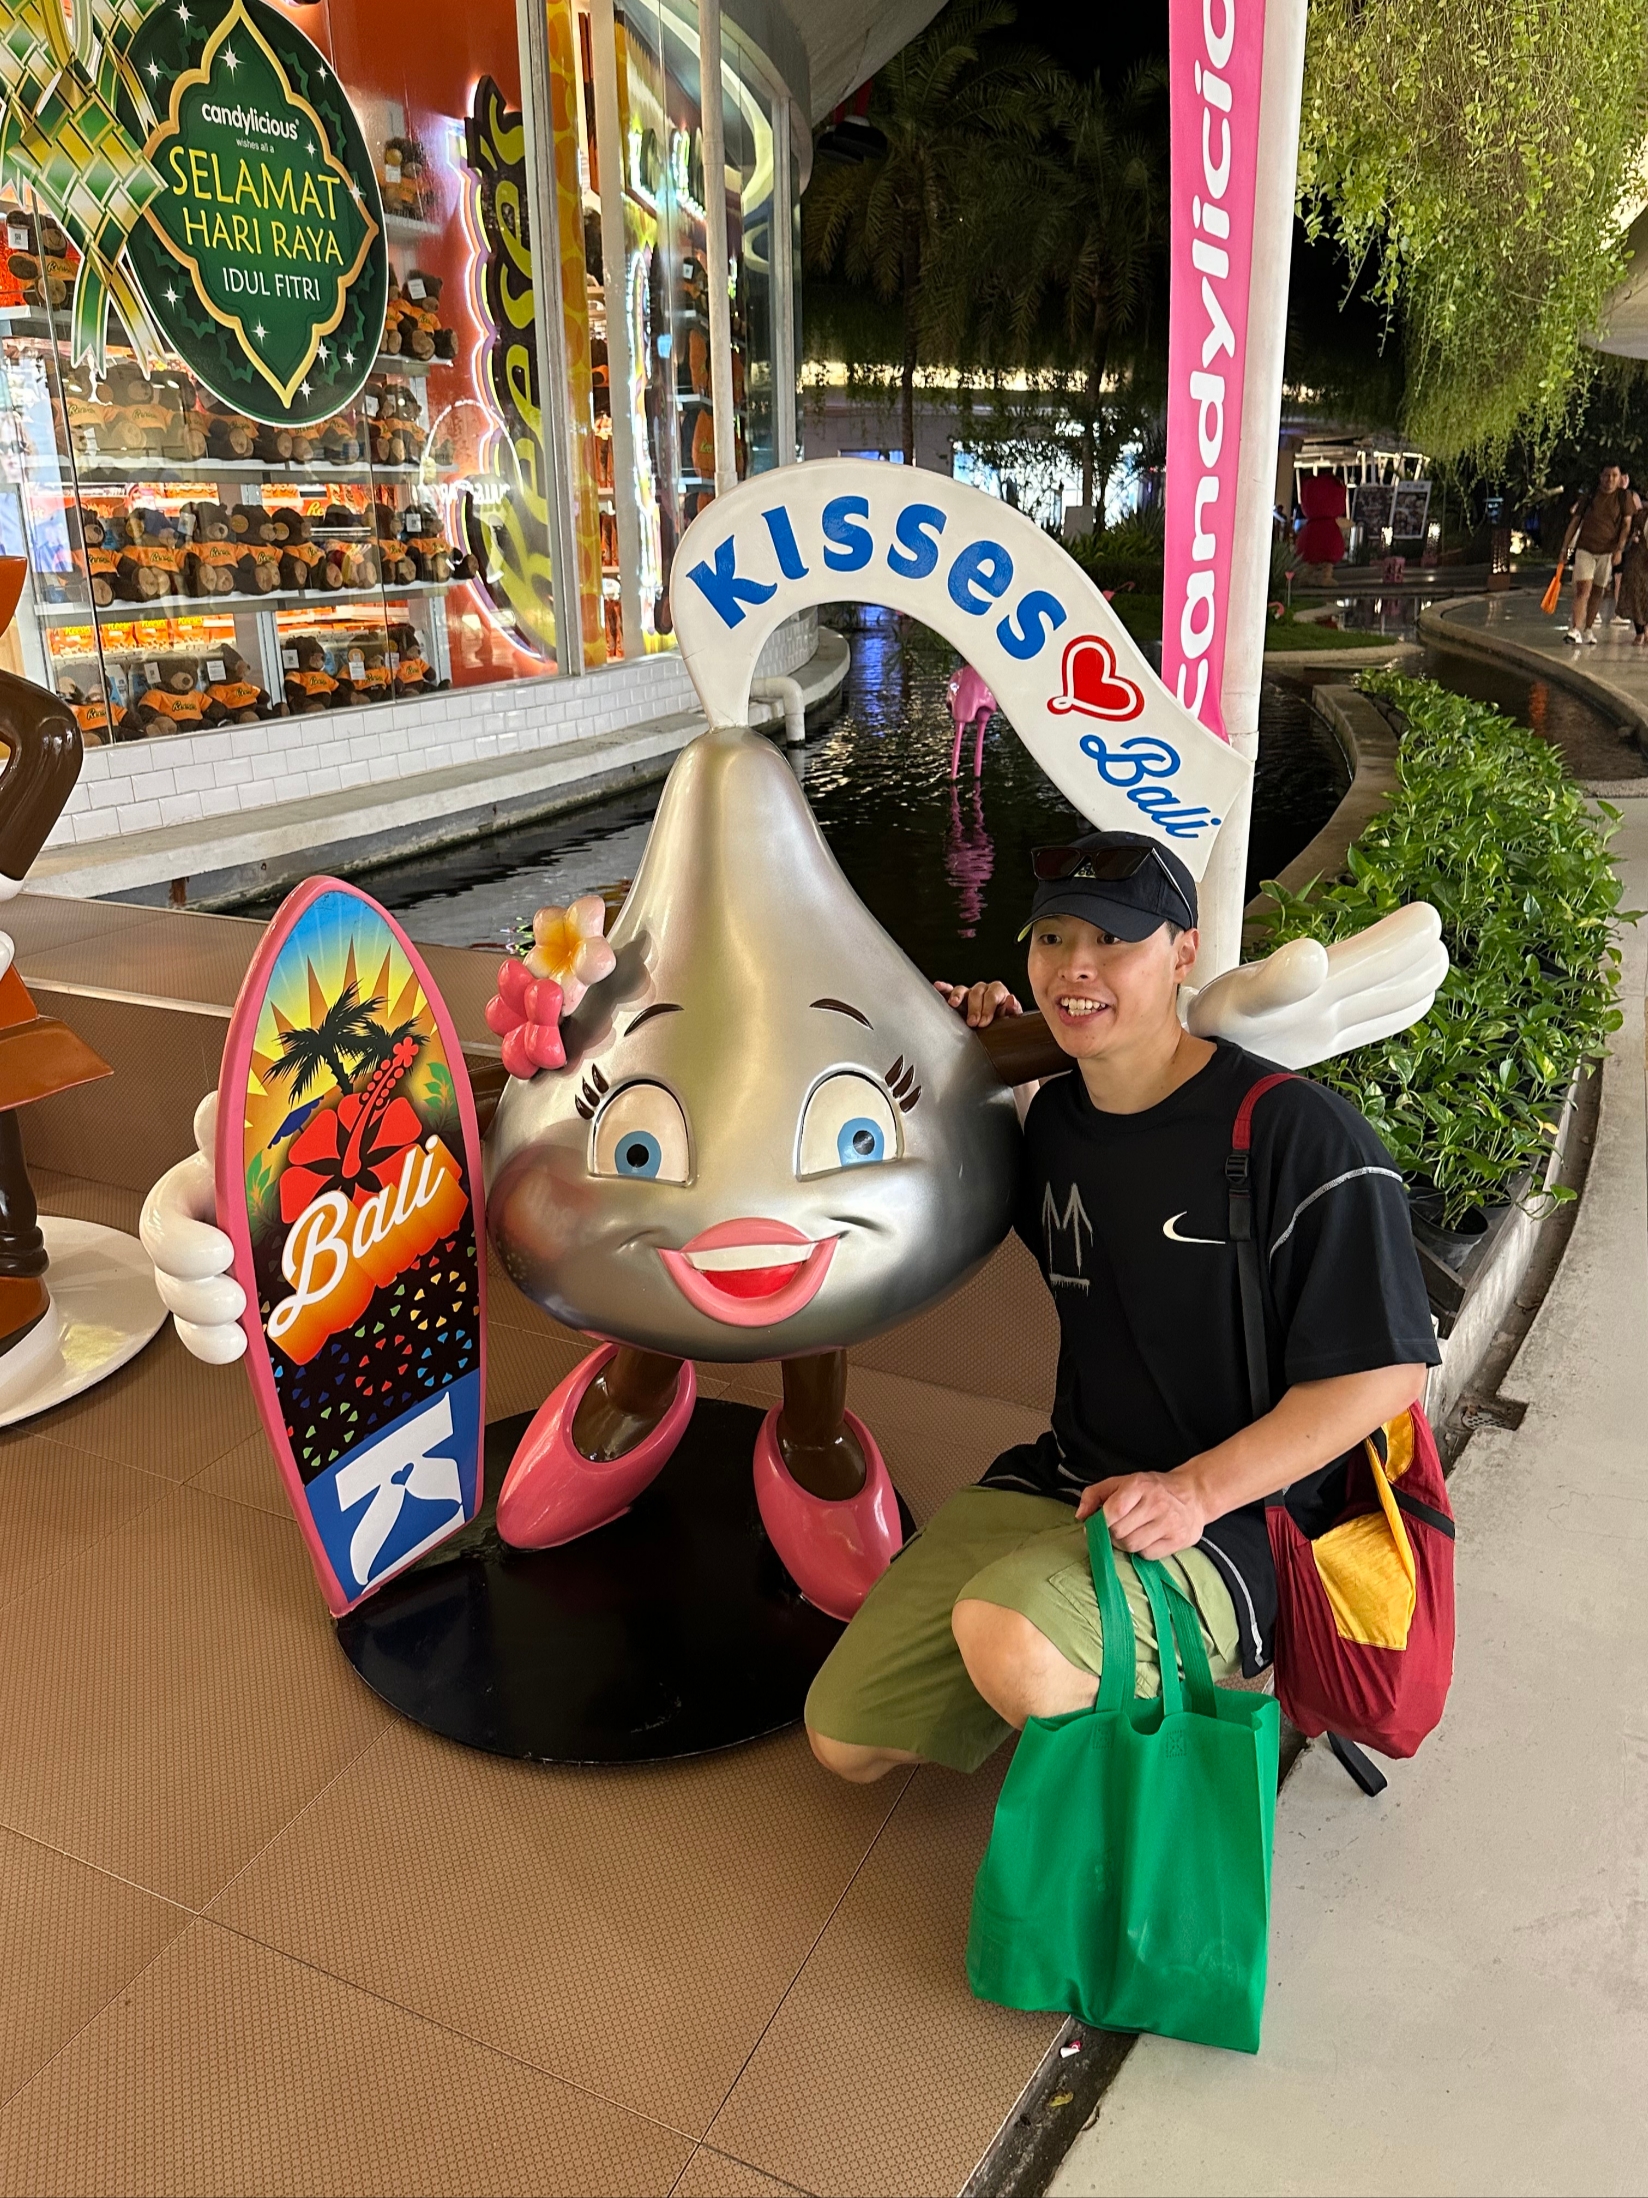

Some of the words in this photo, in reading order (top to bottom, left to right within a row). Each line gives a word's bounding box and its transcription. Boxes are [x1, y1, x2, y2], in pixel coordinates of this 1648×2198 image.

[202, 103, 299, 141] candylicious
[236, 138, 260, 151] wishes
[260, 142, 269, 153] all
[169, 145, 341, 221] SELAMAT
[182, 207, 262, 255] HARI
[271, 220, 344, 266] RAYA
[222, 267, 271, 296] IDUL
[275, 273, 321, 301] FITRI
[1079, 734, 1222, 839] Bali
[267, 1134, 446, 1338] Bali
